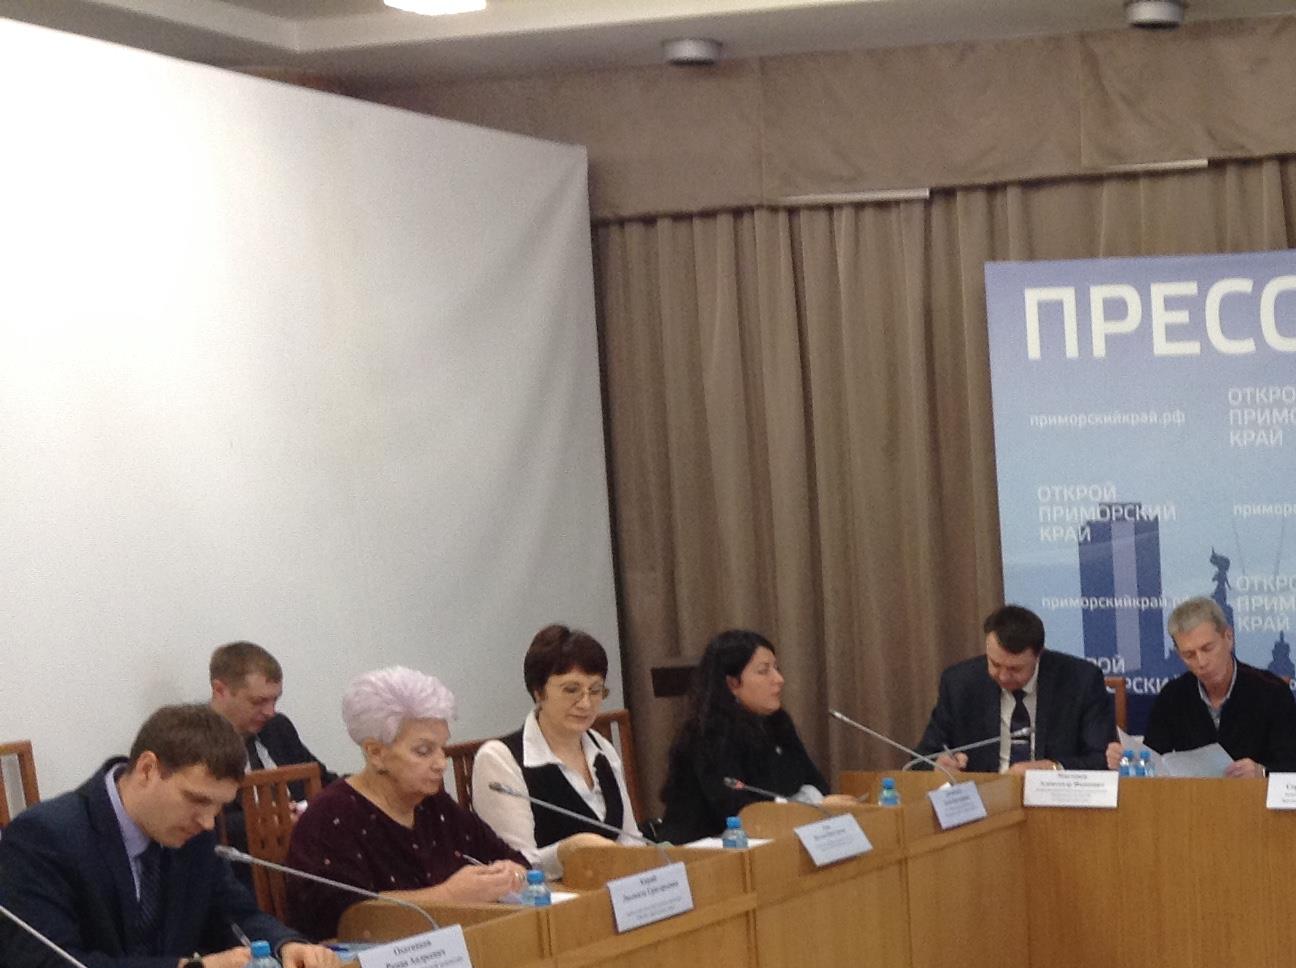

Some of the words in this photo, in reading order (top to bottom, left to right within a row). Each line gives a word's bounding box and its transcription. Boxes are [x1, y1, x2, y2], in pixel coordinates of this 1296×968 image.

[1028, 408, 1187, 430] приморскийкрай.рф
[1228, 427, 1284, 448] КРАЙ
[1037, 482, 1117, 502] ОТКРОЙ
[1038, 501, 1178, 522] ПРИМОРСКИЙ
[1038, 522, 1092, 542] КРАЙ
[1237, 611, 1290, 632] КРАЙ
